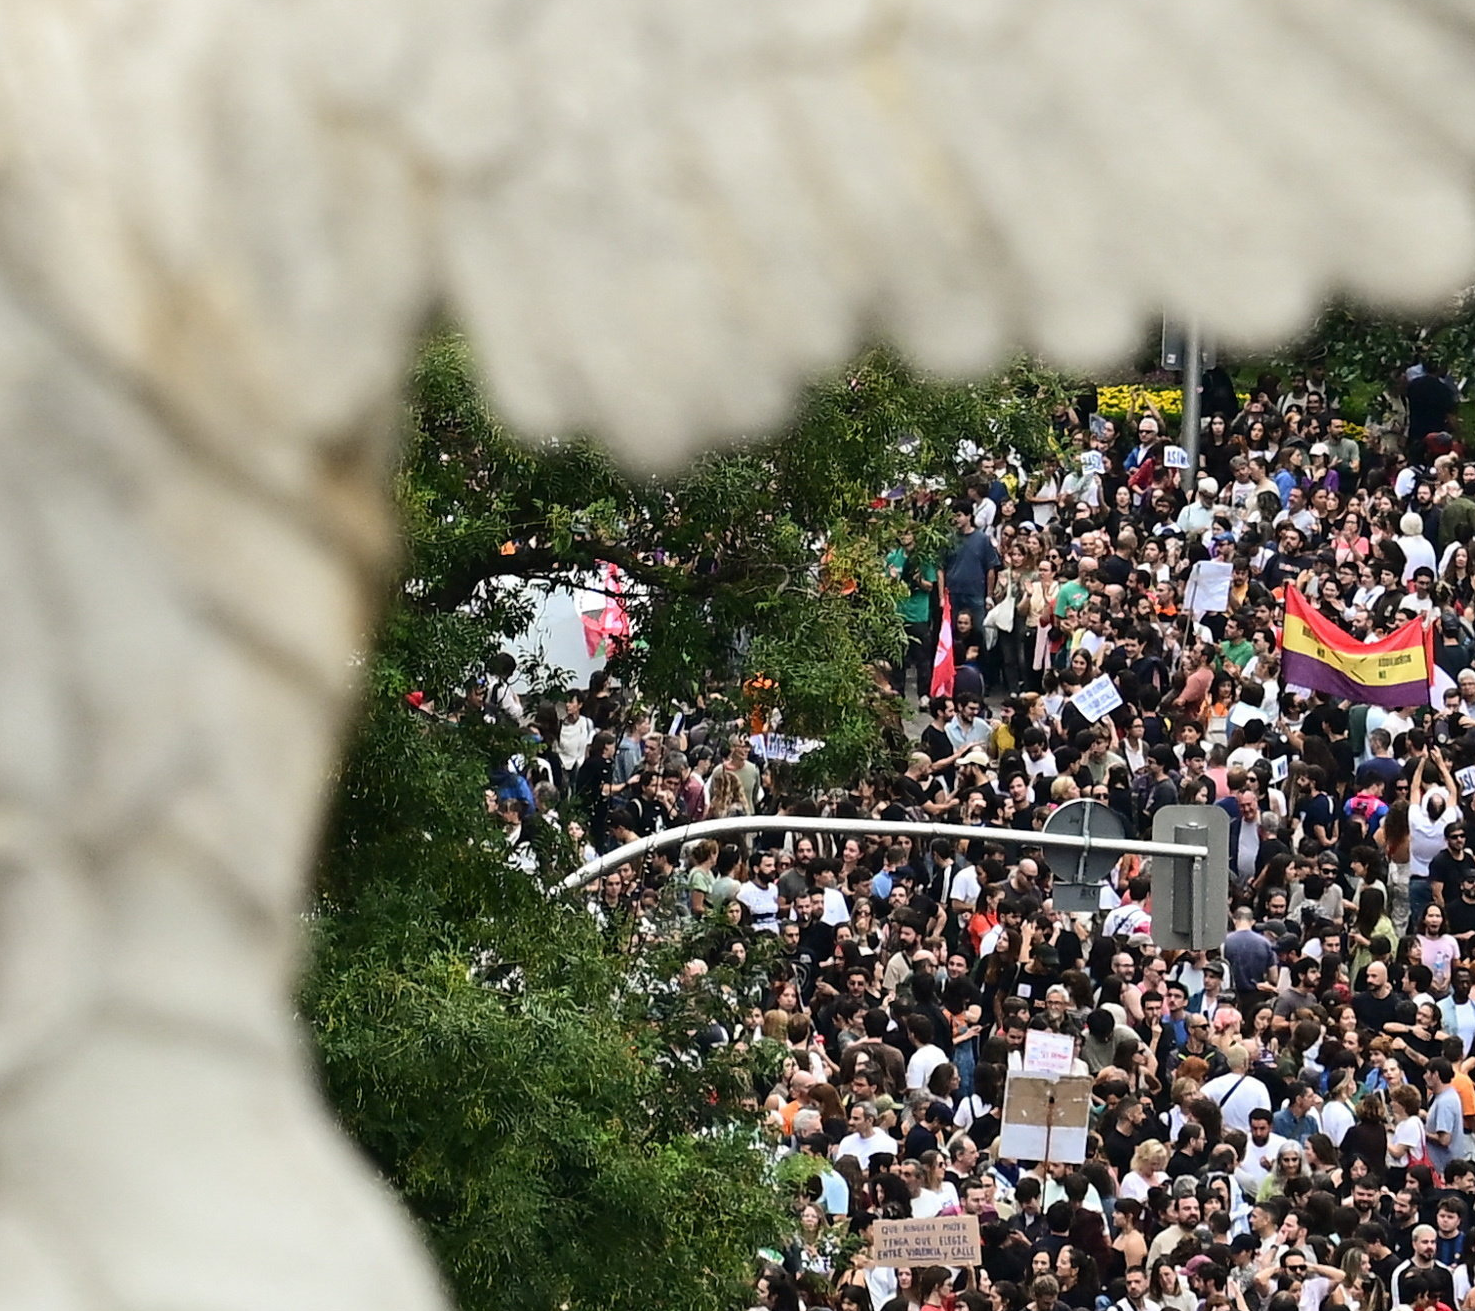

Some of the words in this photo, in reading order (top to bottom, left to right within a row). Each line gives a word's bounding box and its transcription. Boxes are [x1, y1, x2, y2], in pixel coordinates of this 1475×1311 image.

[881, 1224, 898, 1235] QUE
[882, 1238, 910, 1248] TENGA
[914, 1236, 931, 1246] QUE
[939, 1235, 968, 1246] ELEGIR
[877, 1248, 905, 1260] ENTRE
[906, 1247, 942, 1258] VIOLENCIA
[951, 1246, 975, 1257] CALLE
